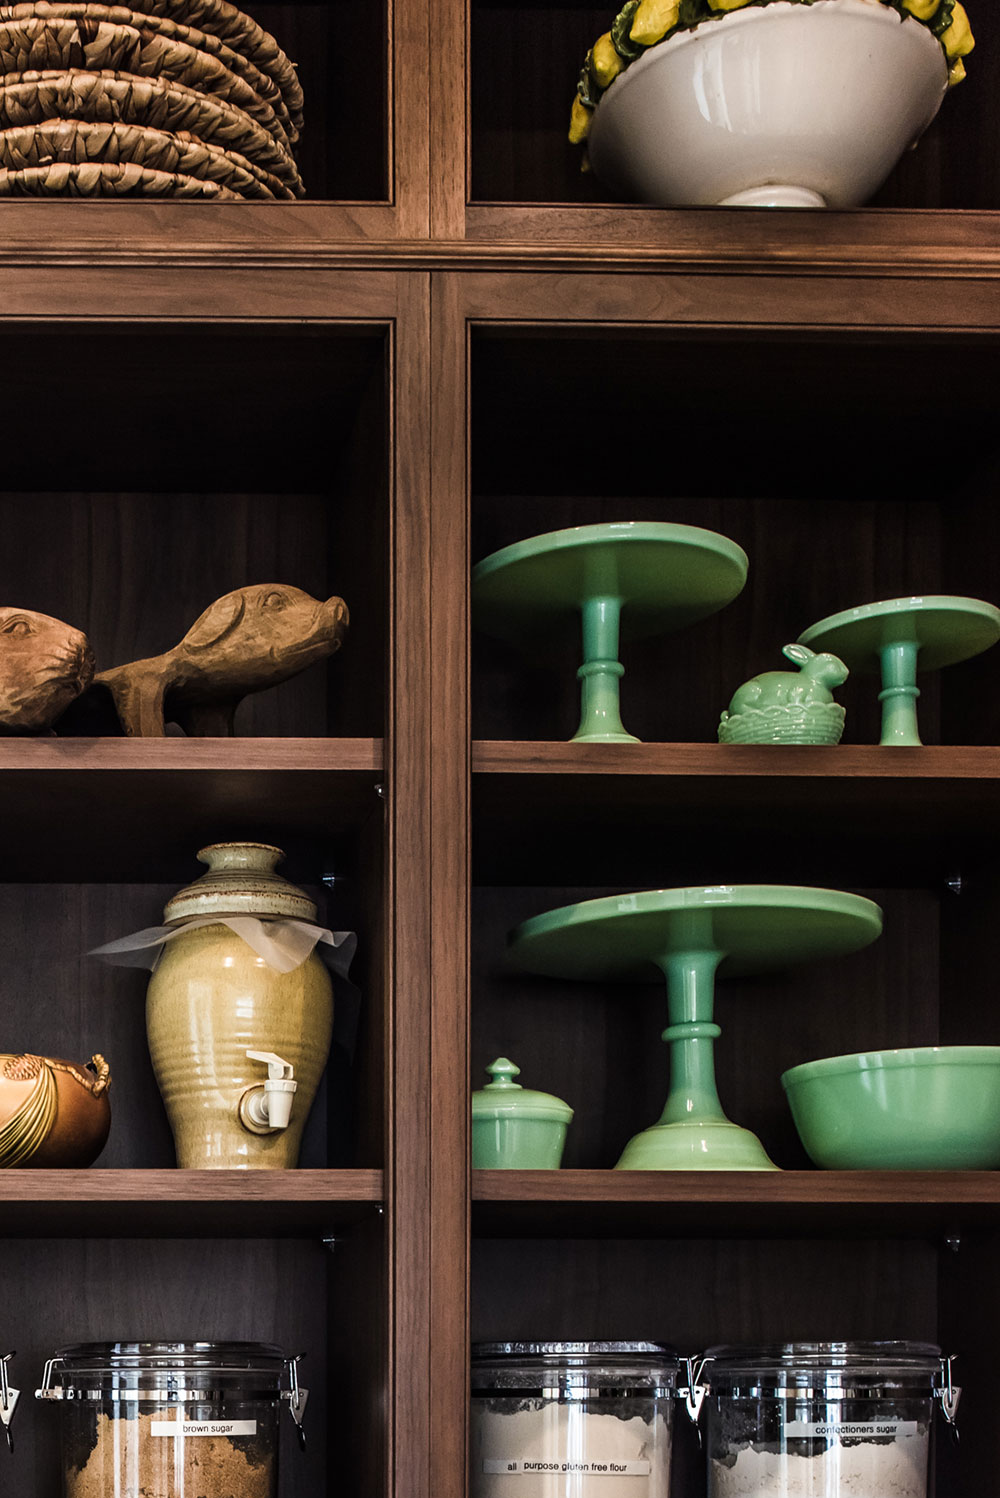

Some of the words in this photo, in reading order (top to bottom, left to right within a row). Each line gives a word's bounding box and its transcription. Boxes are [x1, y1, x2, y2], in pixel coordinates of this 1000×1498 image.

[183, 1425, 209, 1433] brown
[211, 1425, 233, 1434] sugar
[815, 1425, 874, 1434] confectioners
[876, 1425, 897, 1434] sugar
[507, 1462, 517, 1471] all
[524, 1462, 559, 1471] purpose
[562, 1463, 589, 1471] gluten
[591, 1463, 608, 1471] free
[610, 1463, 627, 1471] flour
